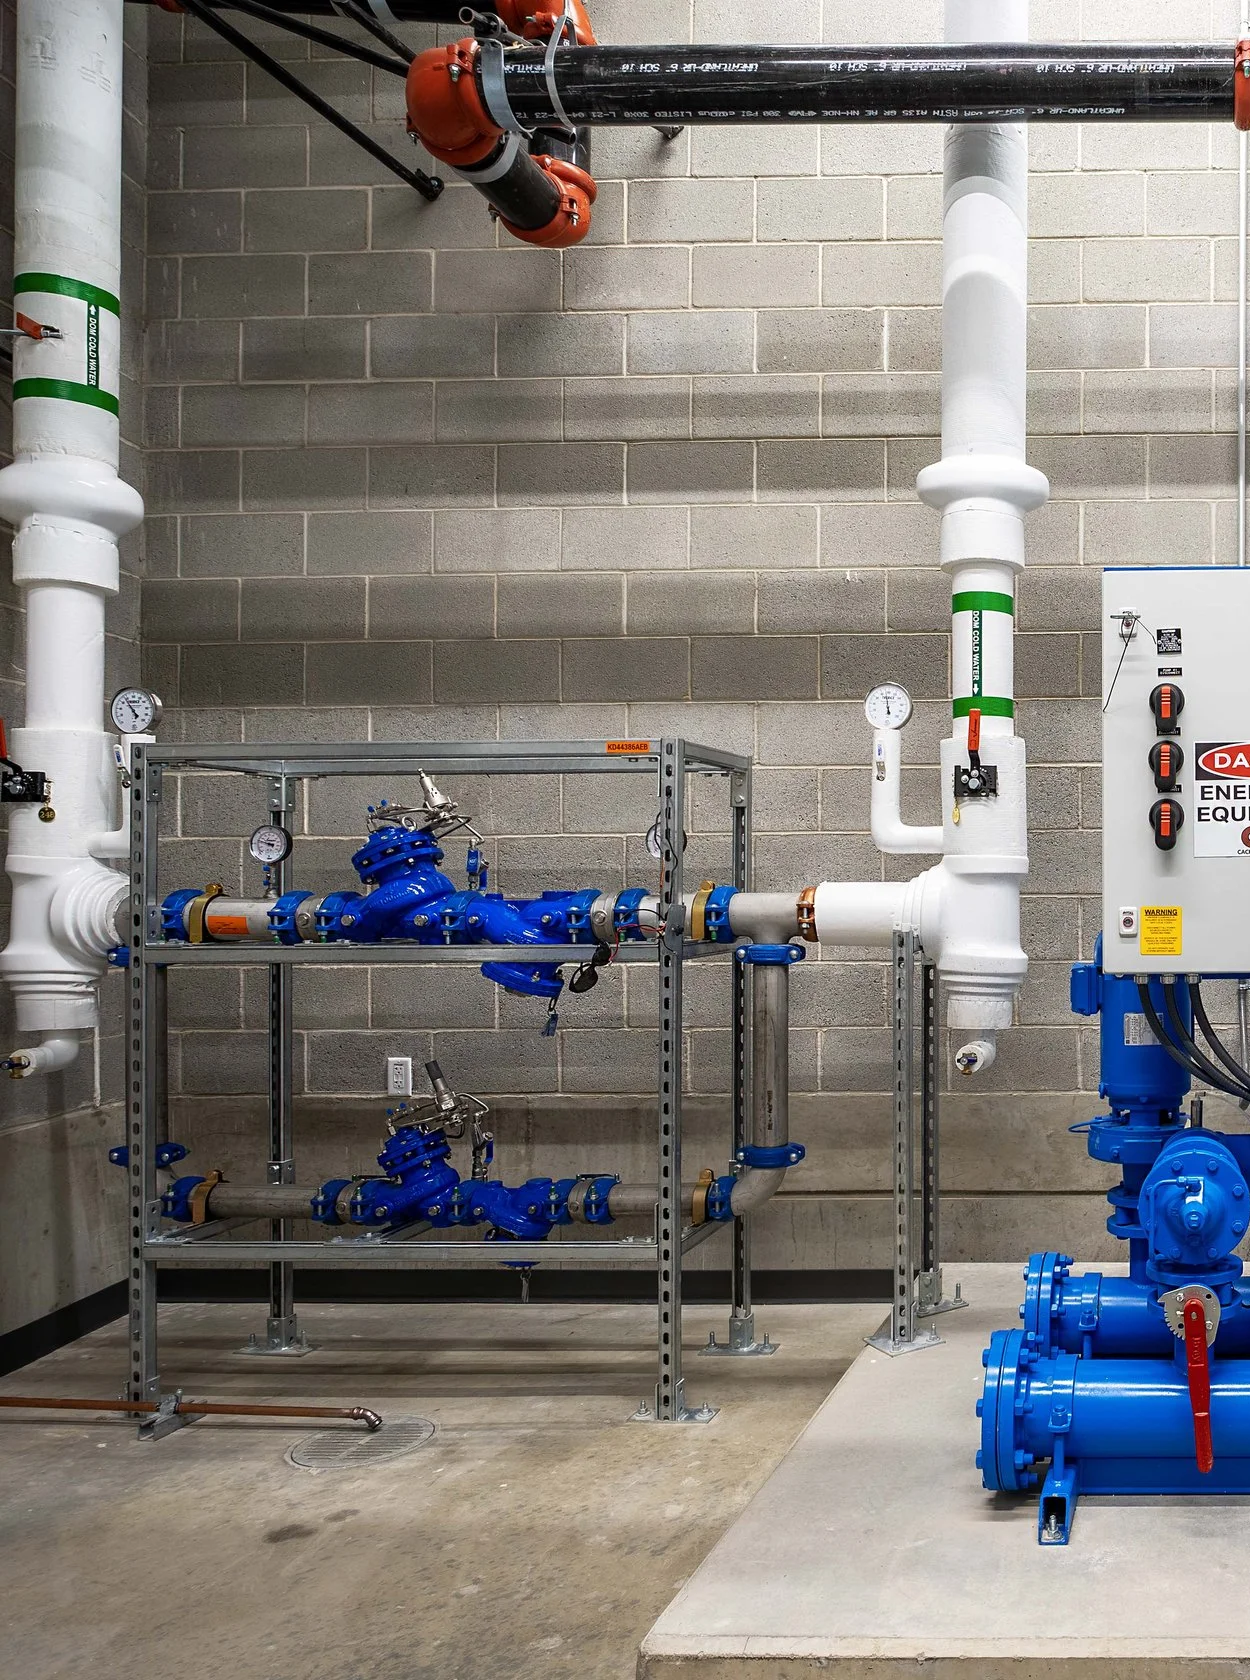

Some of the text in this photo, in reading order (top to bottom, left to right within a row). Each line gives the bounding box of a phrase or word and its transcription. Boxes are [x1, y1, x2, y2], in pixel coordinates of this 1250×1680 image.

[640, 63, 660, 72] SCH
[88, 318, 97, 385] DOM COLD WATER
[972, 611, 980, 680] DOM COLD WATER
